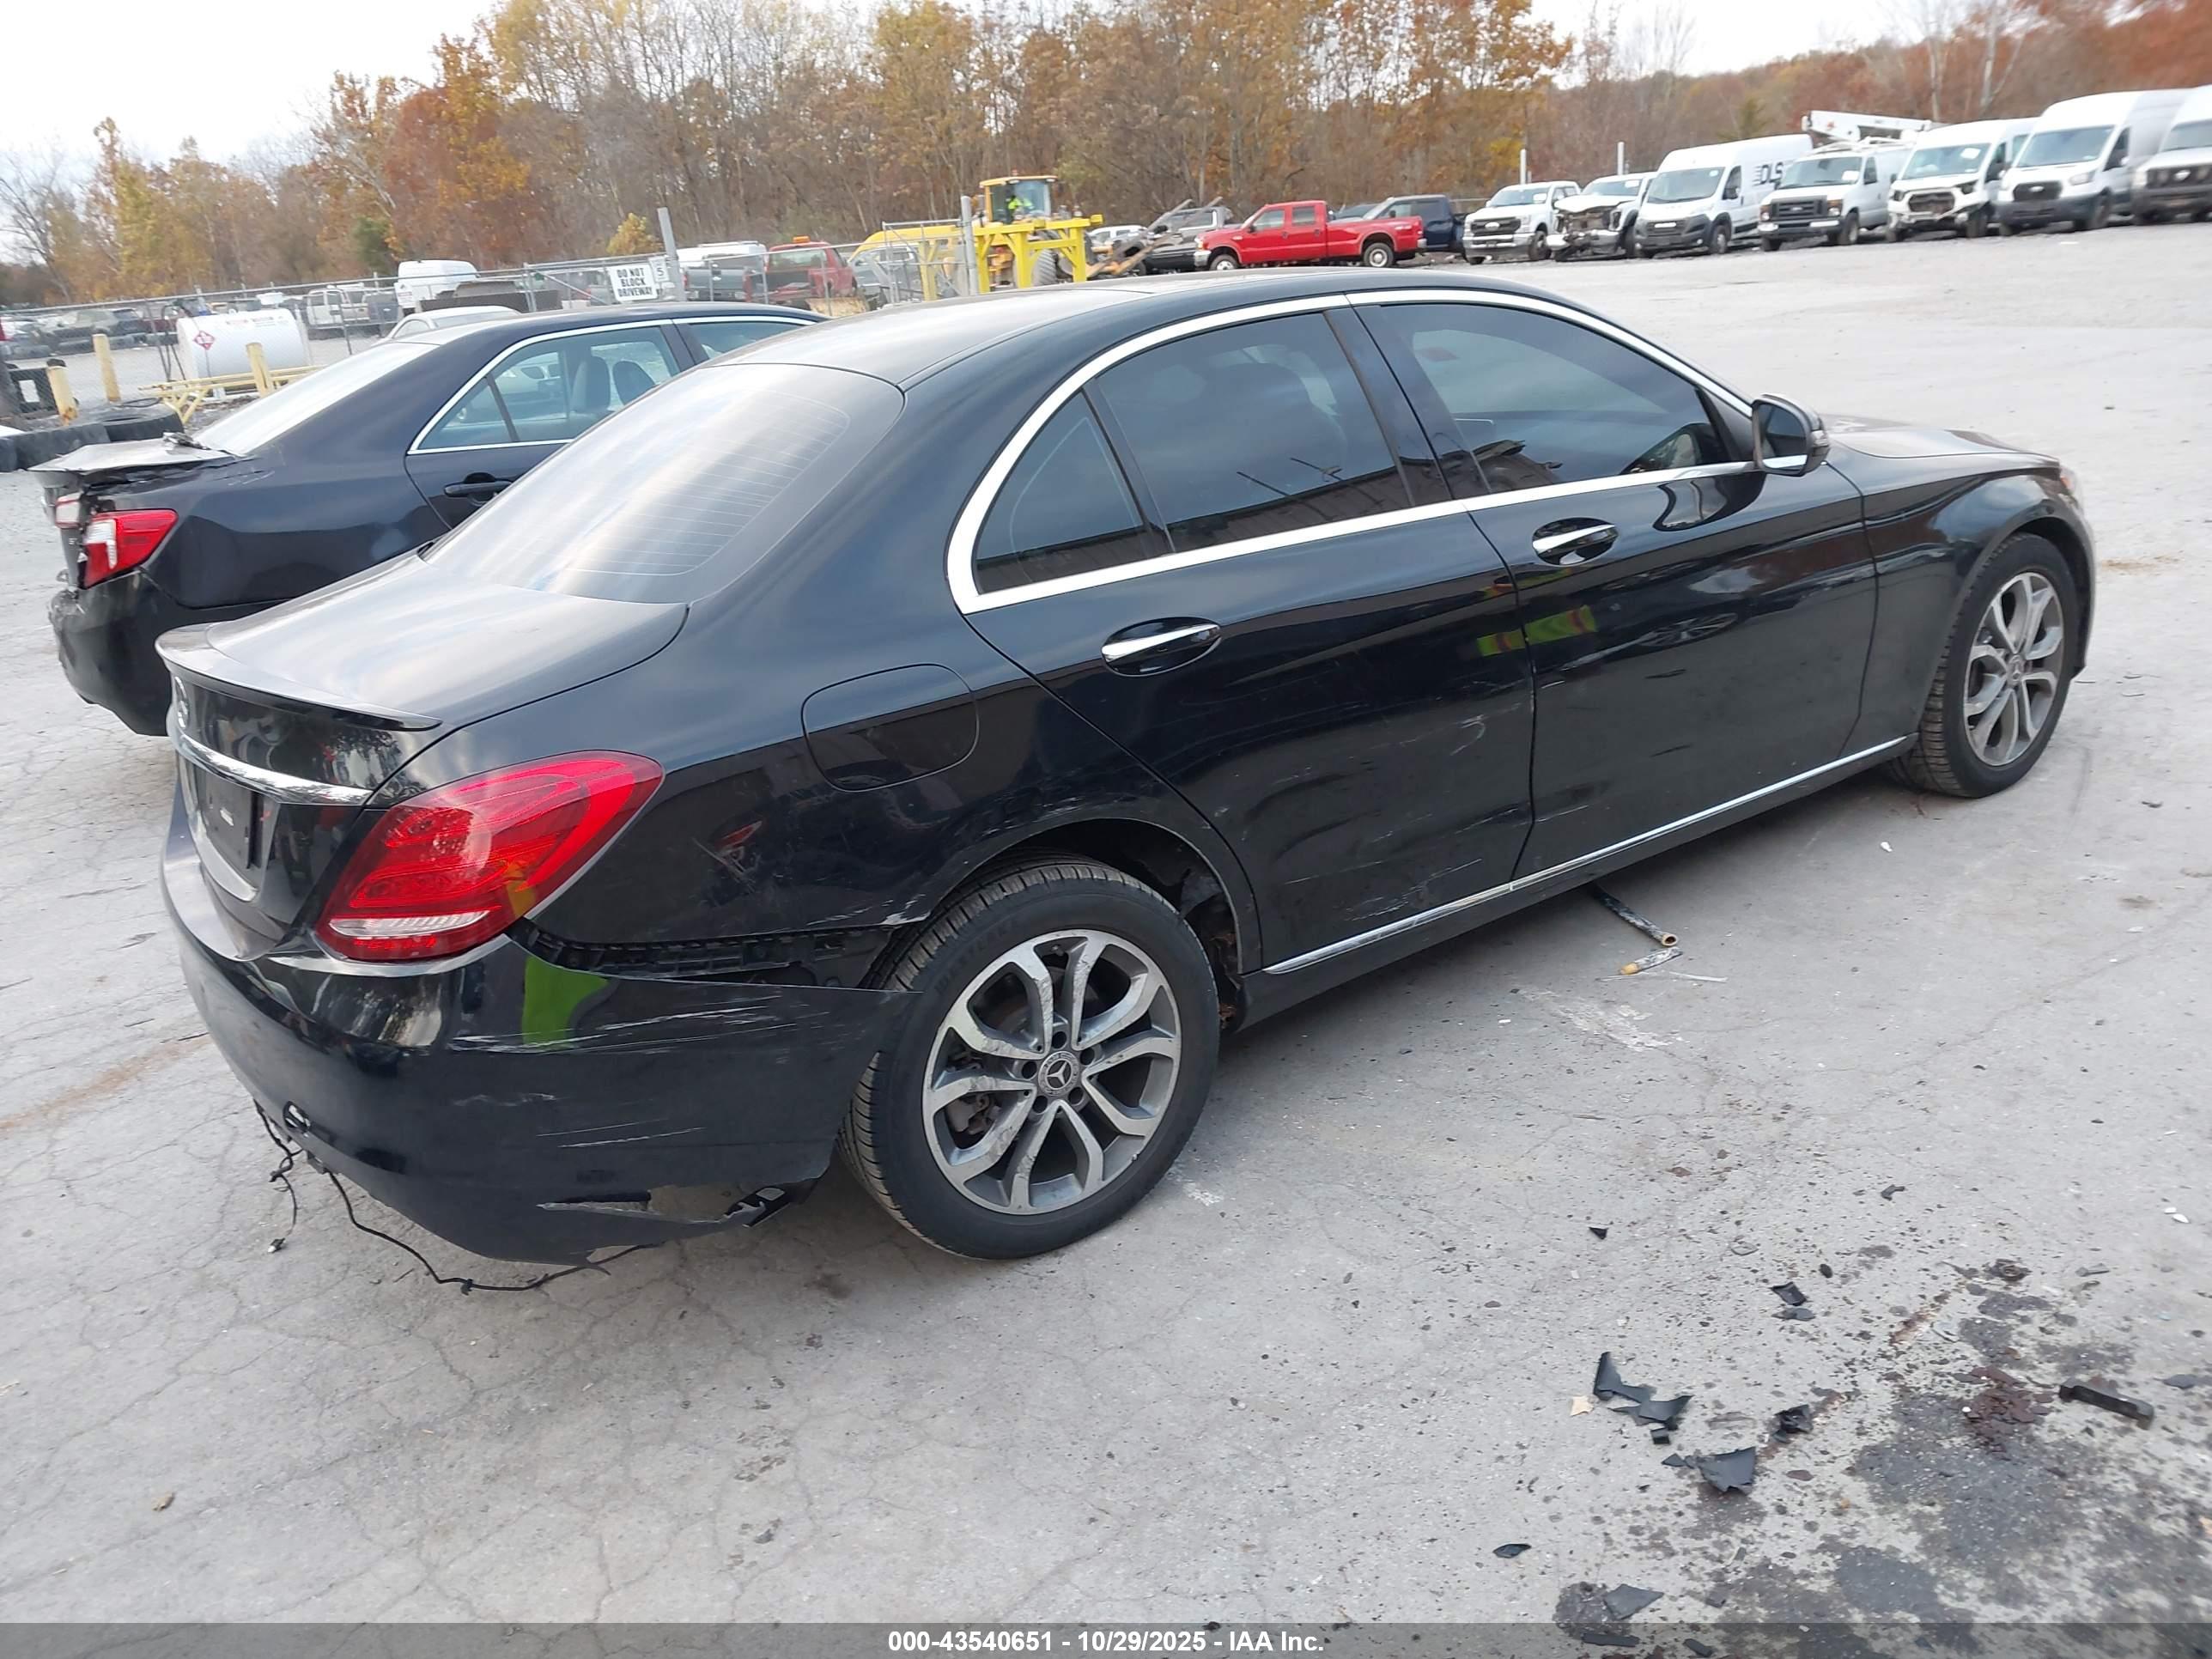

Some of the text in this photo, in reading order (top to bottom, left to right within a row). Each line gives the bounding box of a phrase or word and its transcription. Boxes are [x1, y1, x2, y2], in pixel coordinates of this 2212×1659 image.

[617, 268, 644, 277] DO NOT
[620, 278, 646, 287] BLOCK
[617, 287, 653, 297] DRIVEWAY
